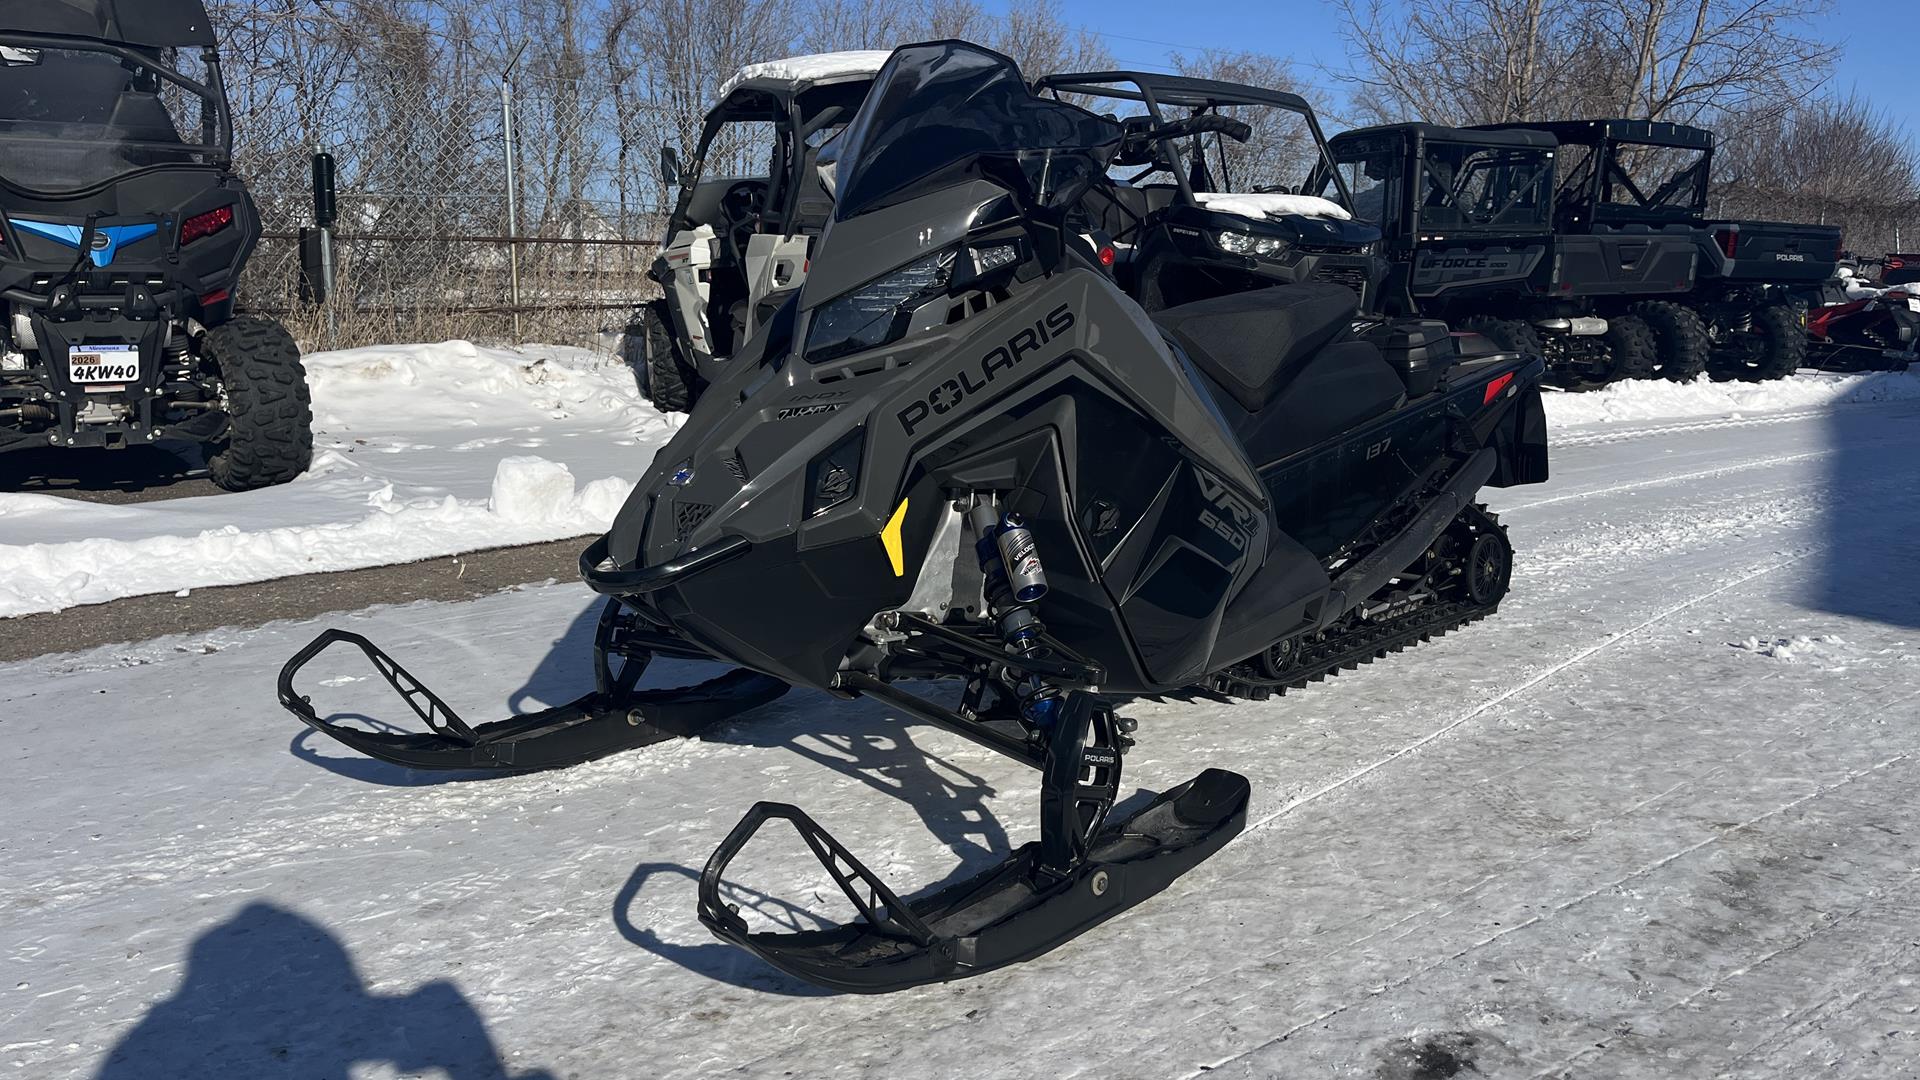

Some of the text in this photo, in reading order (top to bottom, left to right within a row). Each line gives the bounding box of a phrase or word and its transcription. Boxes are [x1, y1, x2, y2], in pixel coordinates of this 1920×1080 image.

[1420, 258, 1489, 269] UFORCE
[1776, 254, 1804, 262] POLARIS
[72, 356, 96, 365] 2026
[73, 365, 136, 380] 4KW40
[897, 302, 1075, 437] POLARIS
[1366, 436, 1392, 460] 137
[1198, 509, 1246, 551] 650
[1084, 754, 1115, 764] POLARIS
